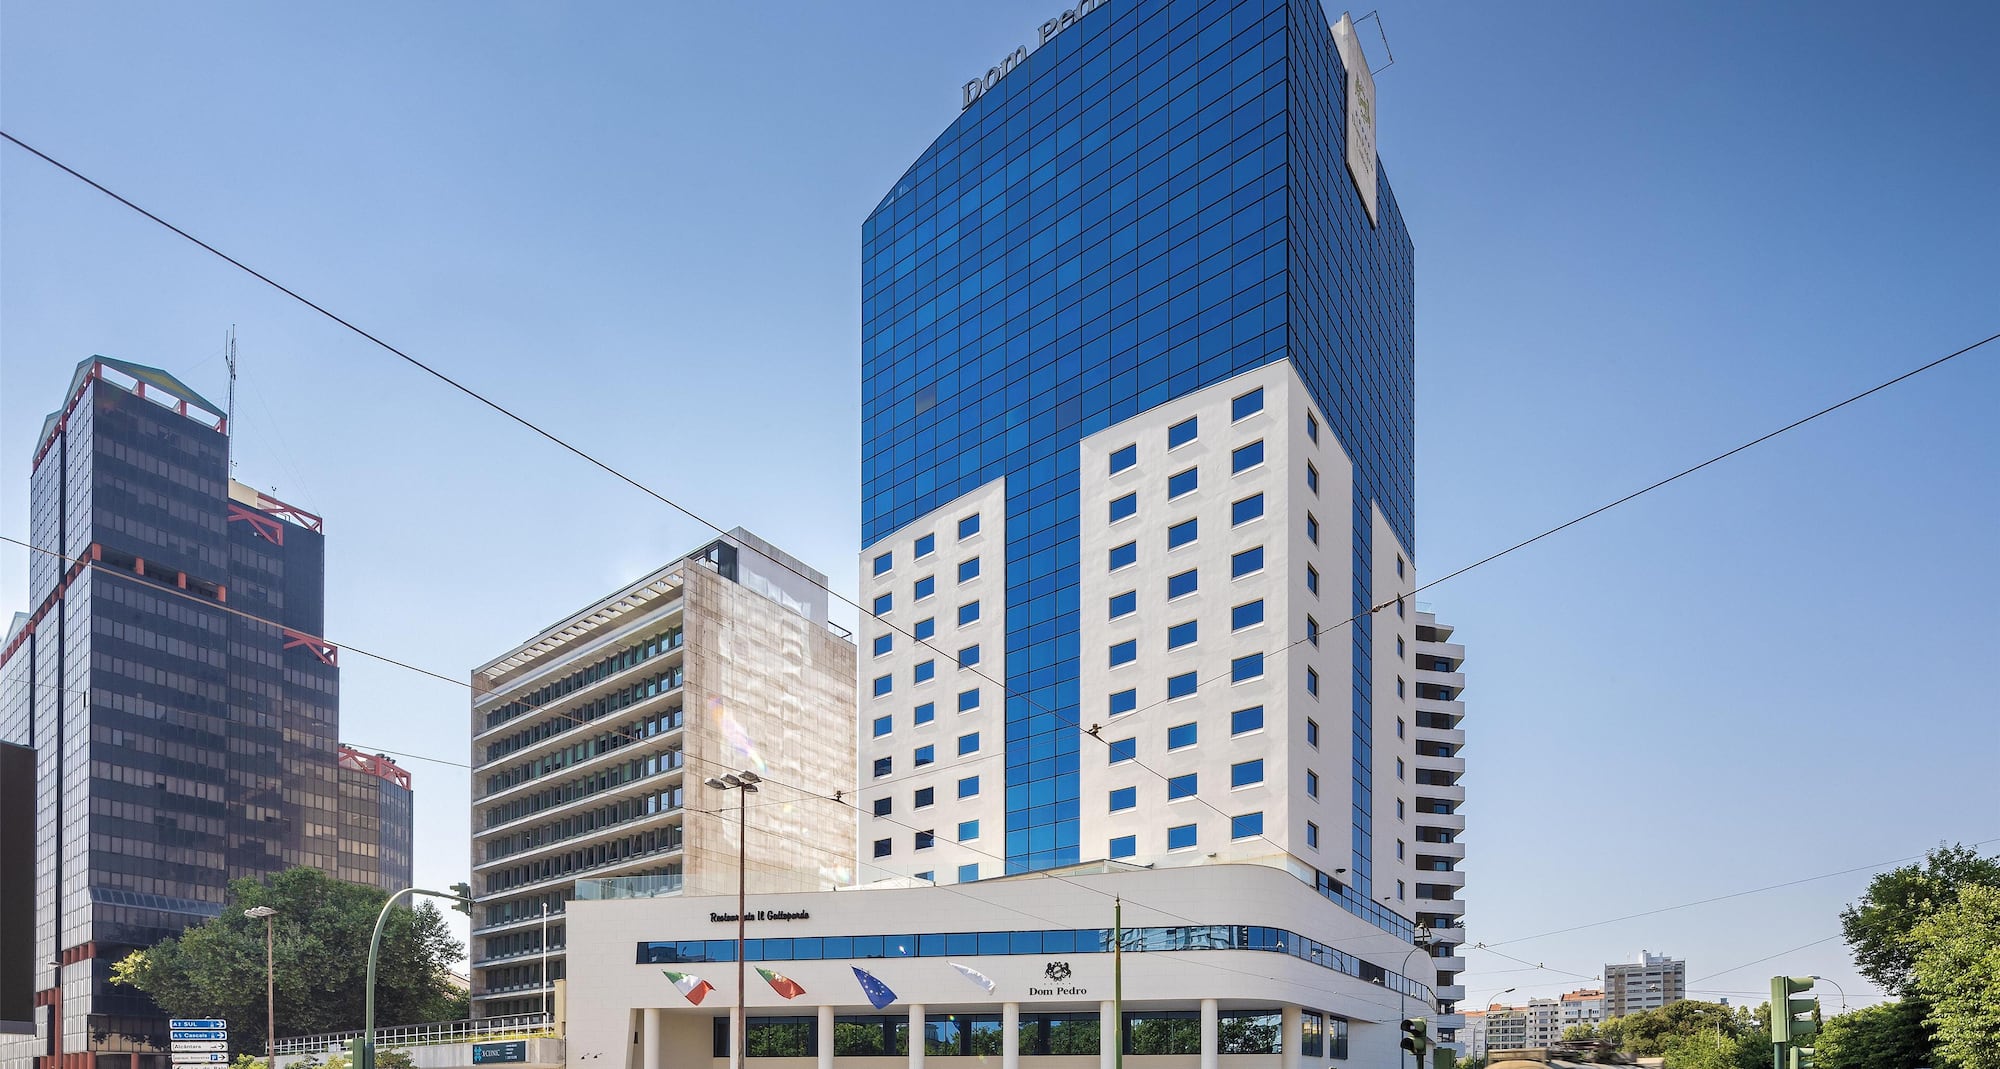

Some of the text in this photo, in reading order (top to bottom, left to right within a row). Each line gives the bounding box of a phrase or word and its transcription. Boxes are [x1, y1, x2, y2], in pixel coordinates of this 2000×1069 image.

[961, 44, 1027, 111] Dom
[1029, 986, 1087, 996] Dom Pedro
